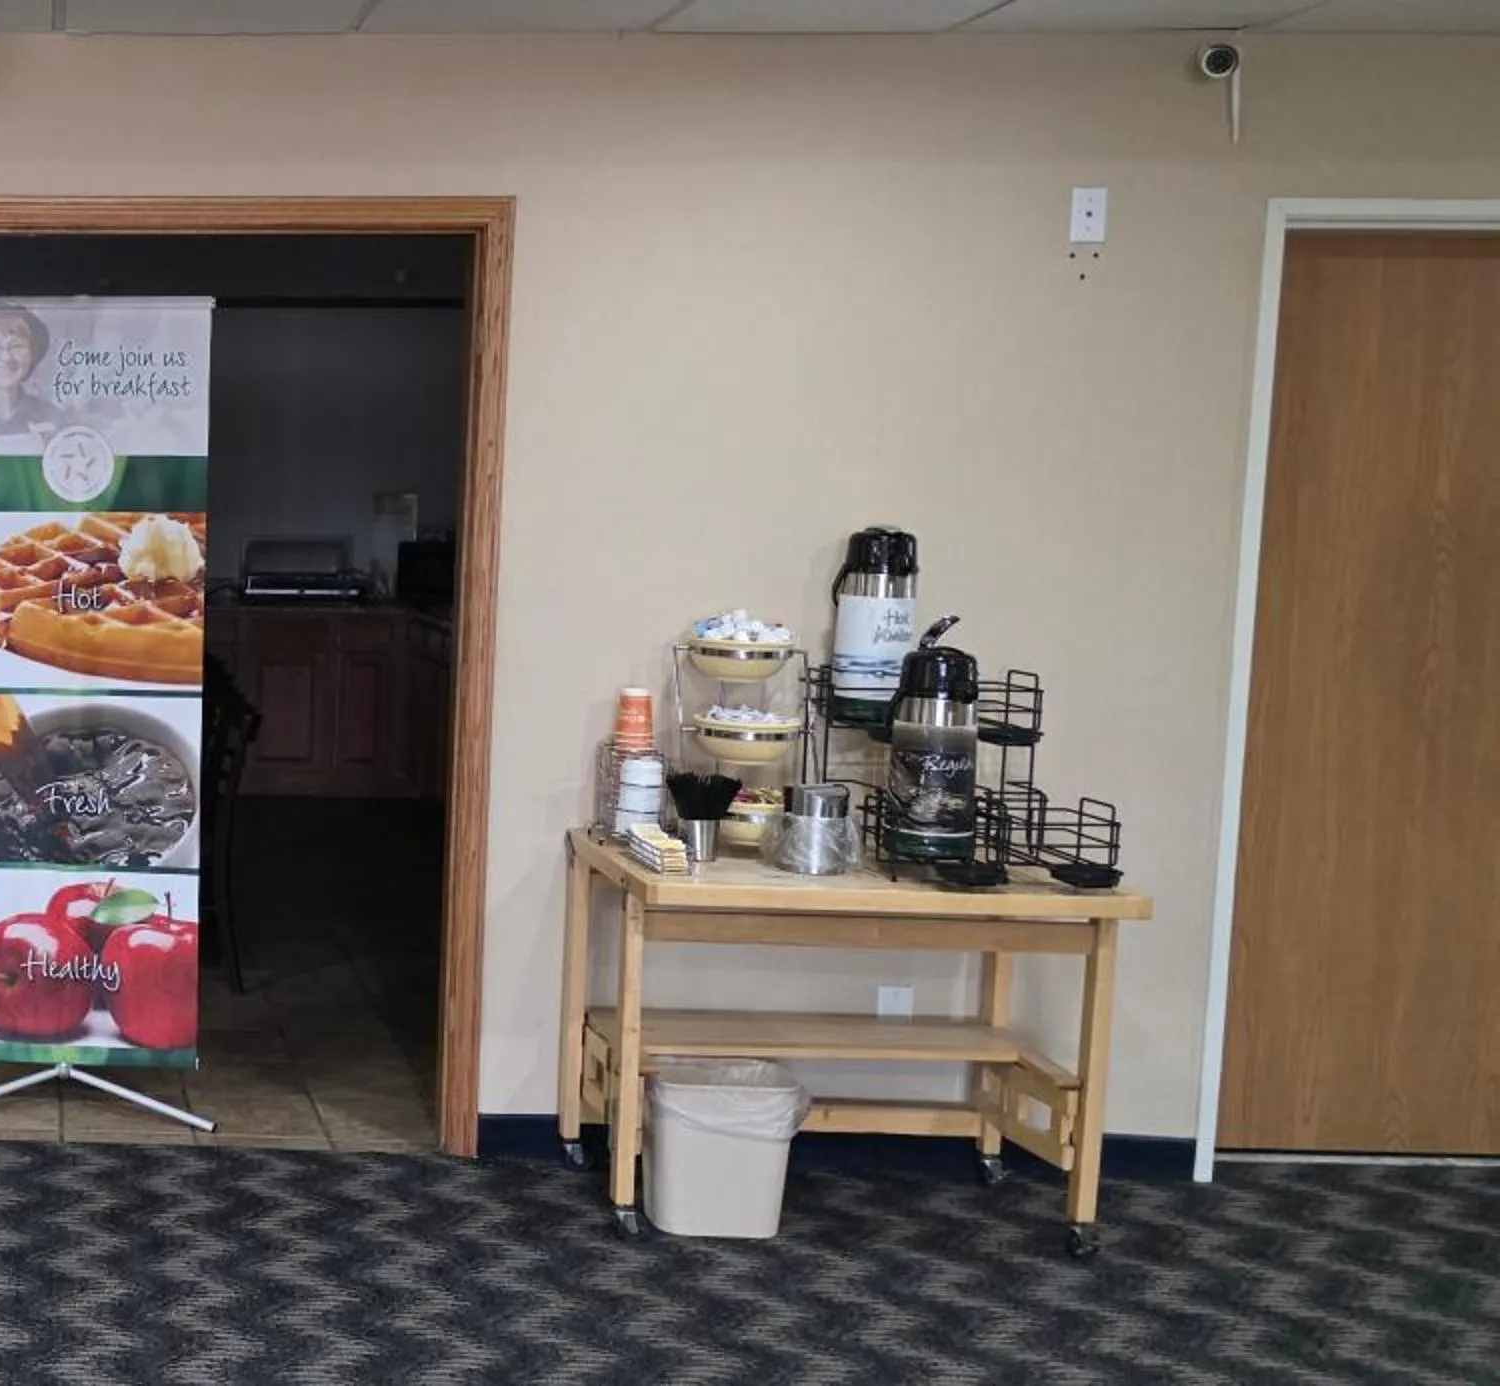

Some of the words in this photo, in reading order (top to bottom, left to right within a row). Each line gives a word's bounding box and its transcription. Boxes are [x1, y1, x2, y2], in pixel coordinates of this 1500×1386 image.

[58, 340, 112, 367] Come
[115, 344, 153, 377] join
[163, 351, 187, 367] us
[52, 371, 85, 403] for
[91, 371, 192, 404] breakfast
[52, 581, 102, 613] Hot
[35, 781, 112, 814] Fresh
[19, 948, 120, 991] Healthy
